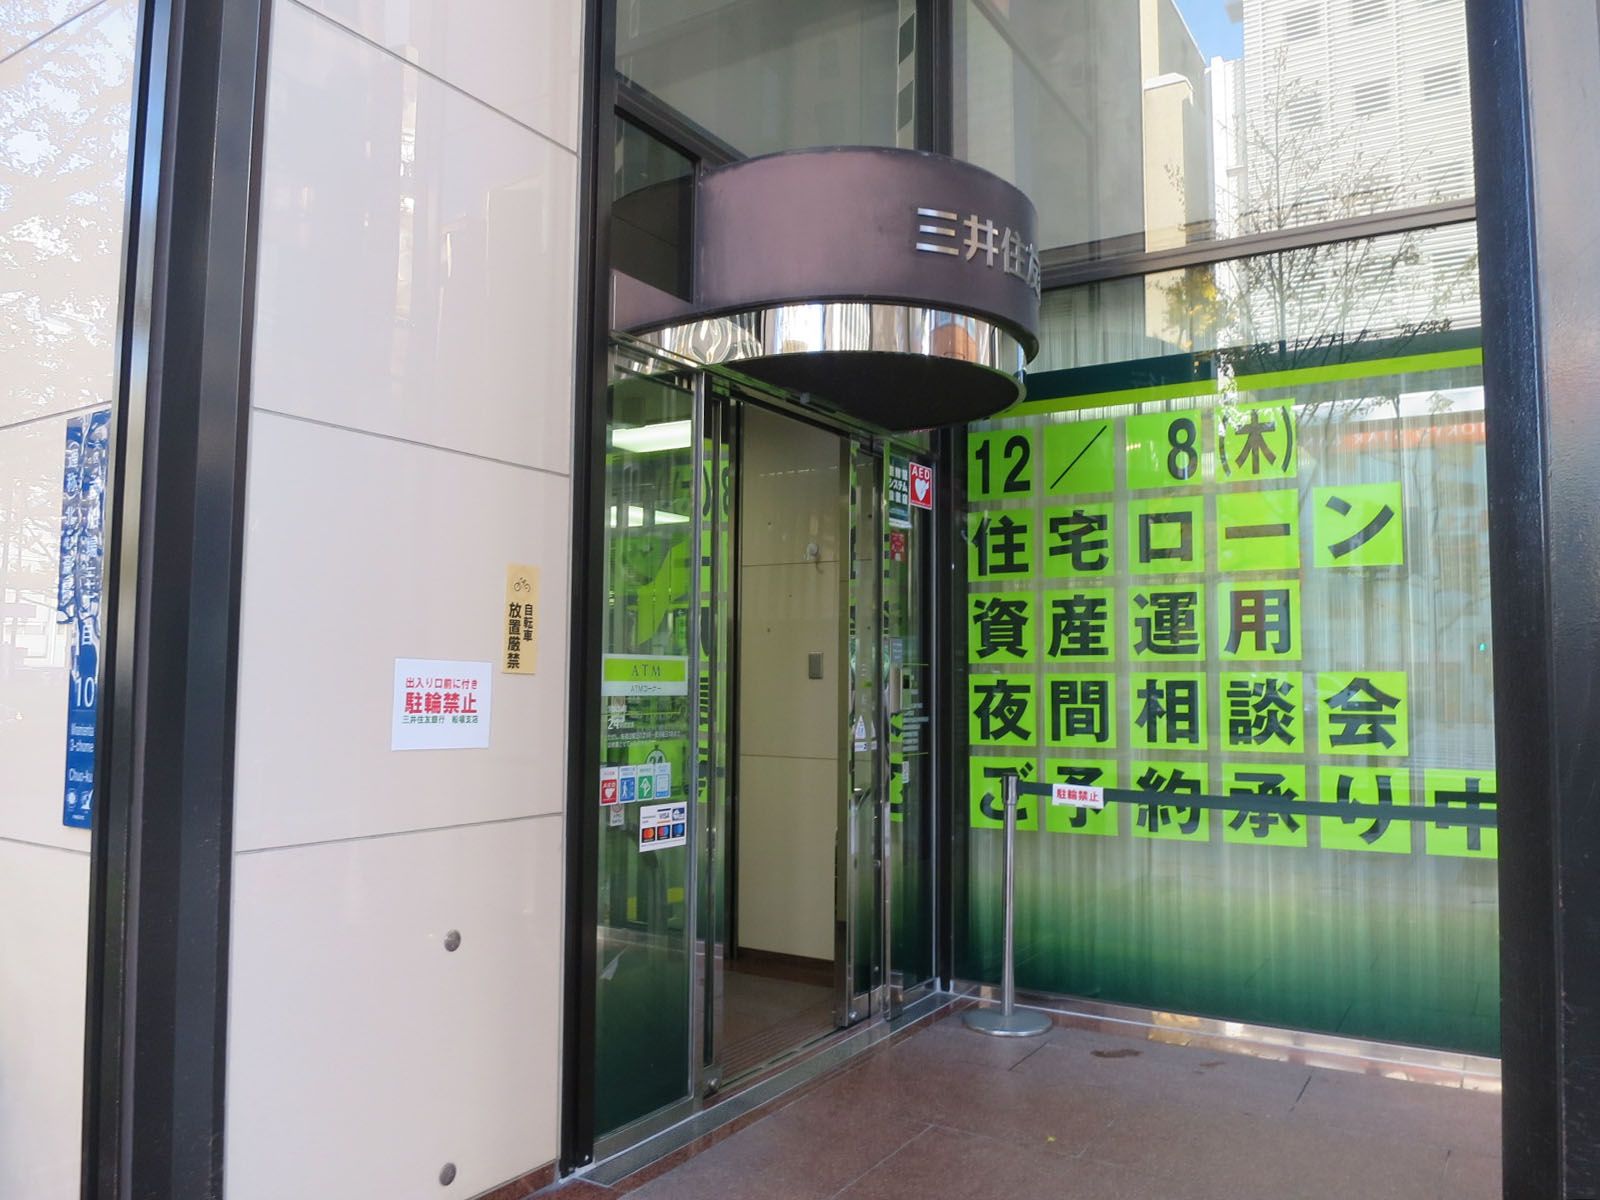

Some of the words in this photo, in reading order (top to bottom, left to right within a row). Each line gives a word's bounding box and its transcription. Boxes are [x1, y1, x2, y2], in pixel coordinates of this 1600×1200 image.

[911, 465, 930, 480] AED
[971, 494, 1395, 577] 住宅ローン
[507, 601, 522, 670] 放置厳禁
[522, 603, 534, 642] 自転車
[972, 590, 1291, 659] 資産運用
[405, 677, 478, 691] 出入り口前に付き
[631, 664, 661, 677] ATM
[74, 677, 96, 708] 10
[404, 691, 478, 714] 駐輪禁止
[972, 677, 1402, 750] 夜間相談会
[1056, 788, 1100, 802] 駐輪禁止
